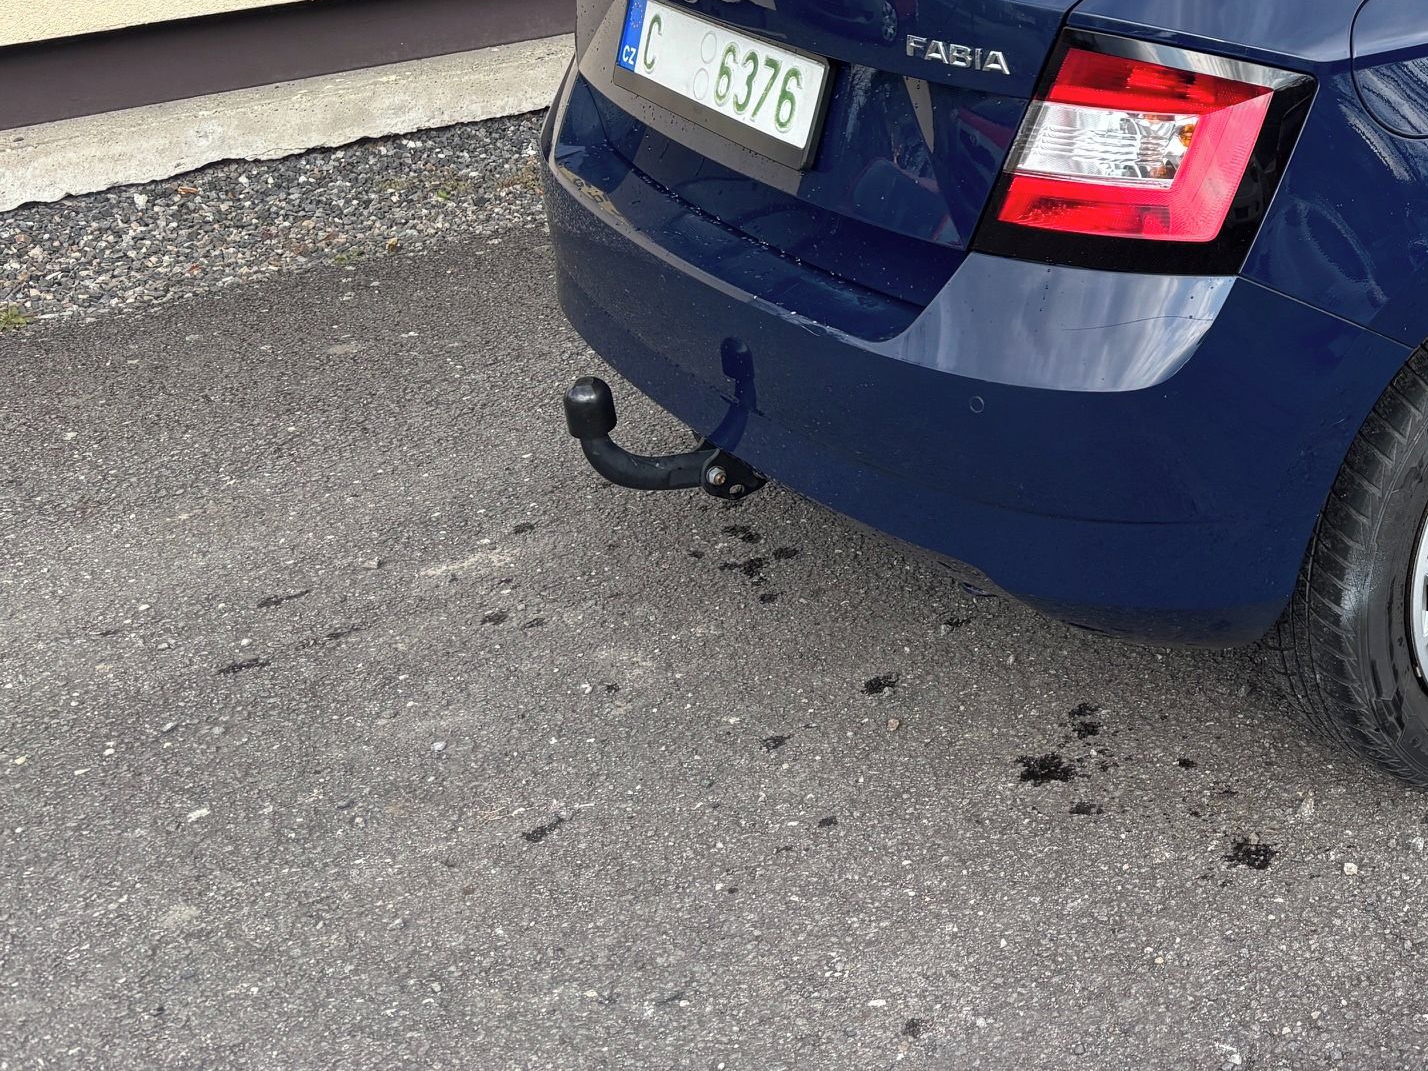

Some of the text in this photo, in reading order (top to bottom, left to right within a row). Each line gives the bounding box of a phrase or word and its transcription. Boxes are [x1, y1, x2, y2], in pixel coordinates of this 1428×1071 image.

[622, 45, 636, 67] CZ
[642, 14, 803, 133] C 6376
[905, 34, 1011, 76] FABIA
